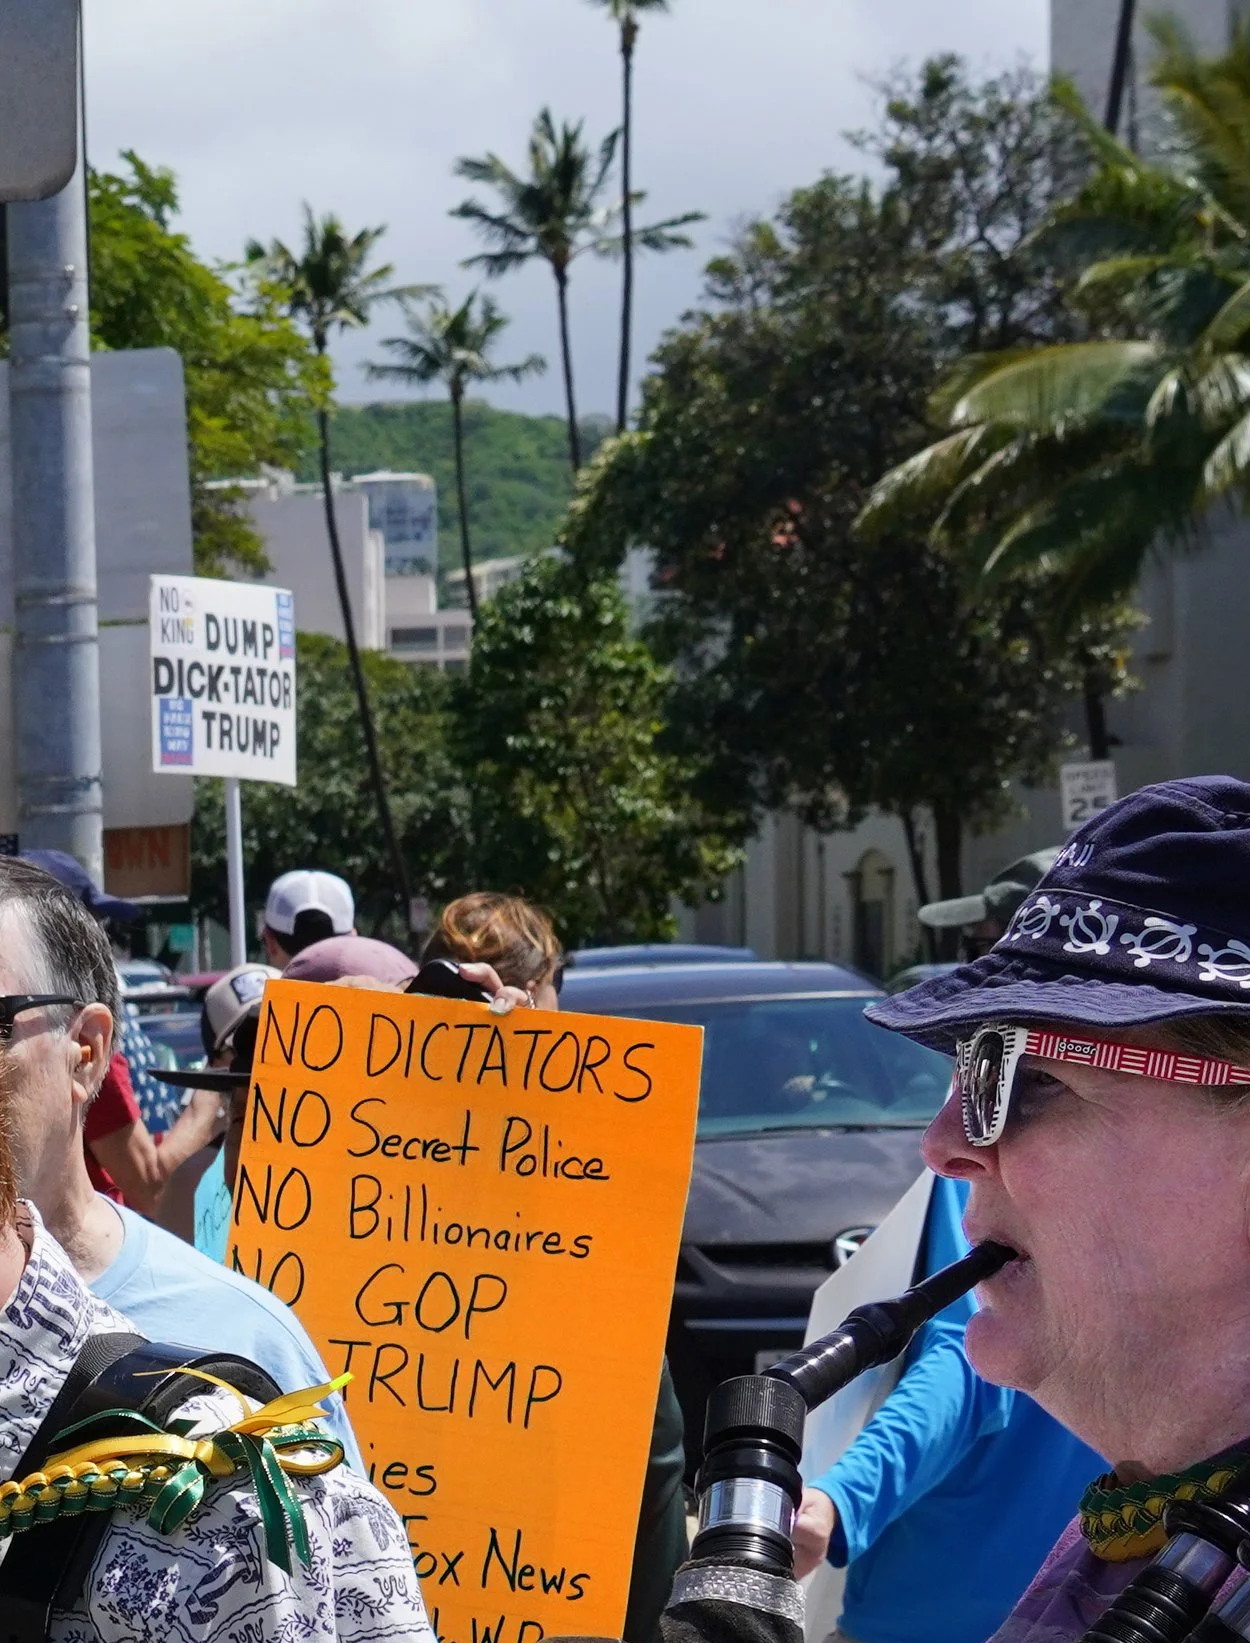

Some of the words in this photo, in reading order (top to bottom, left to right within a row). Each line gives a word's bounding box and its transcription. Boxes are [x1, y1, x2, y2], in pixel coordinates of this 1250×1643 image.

[160, 587, 179, 613] NO
[204, 613, 274, 660] DUMP
[202, 711, 280, 760] TRUMP
[261, 1000, 344, 1072] NO
[366, 1013, 655, 1103] DICTATORS
[1058, 1042, 1097, 1055] goodr
[252, 1083, 331, 1147] NO
[347, 1098, 480, 1166] Secret
[501, 1116, 610, 1180] Police
[234, 1164, 312, 1230] NO
[350, 1174, 593, 1259] Billionaires
[355, 1263, 508, 1340] GOP
[328, 1339, 562, 1430] TRUMP
[369, 1443, 437, 1496] ies
[481, 1527, 591, 1601] News
